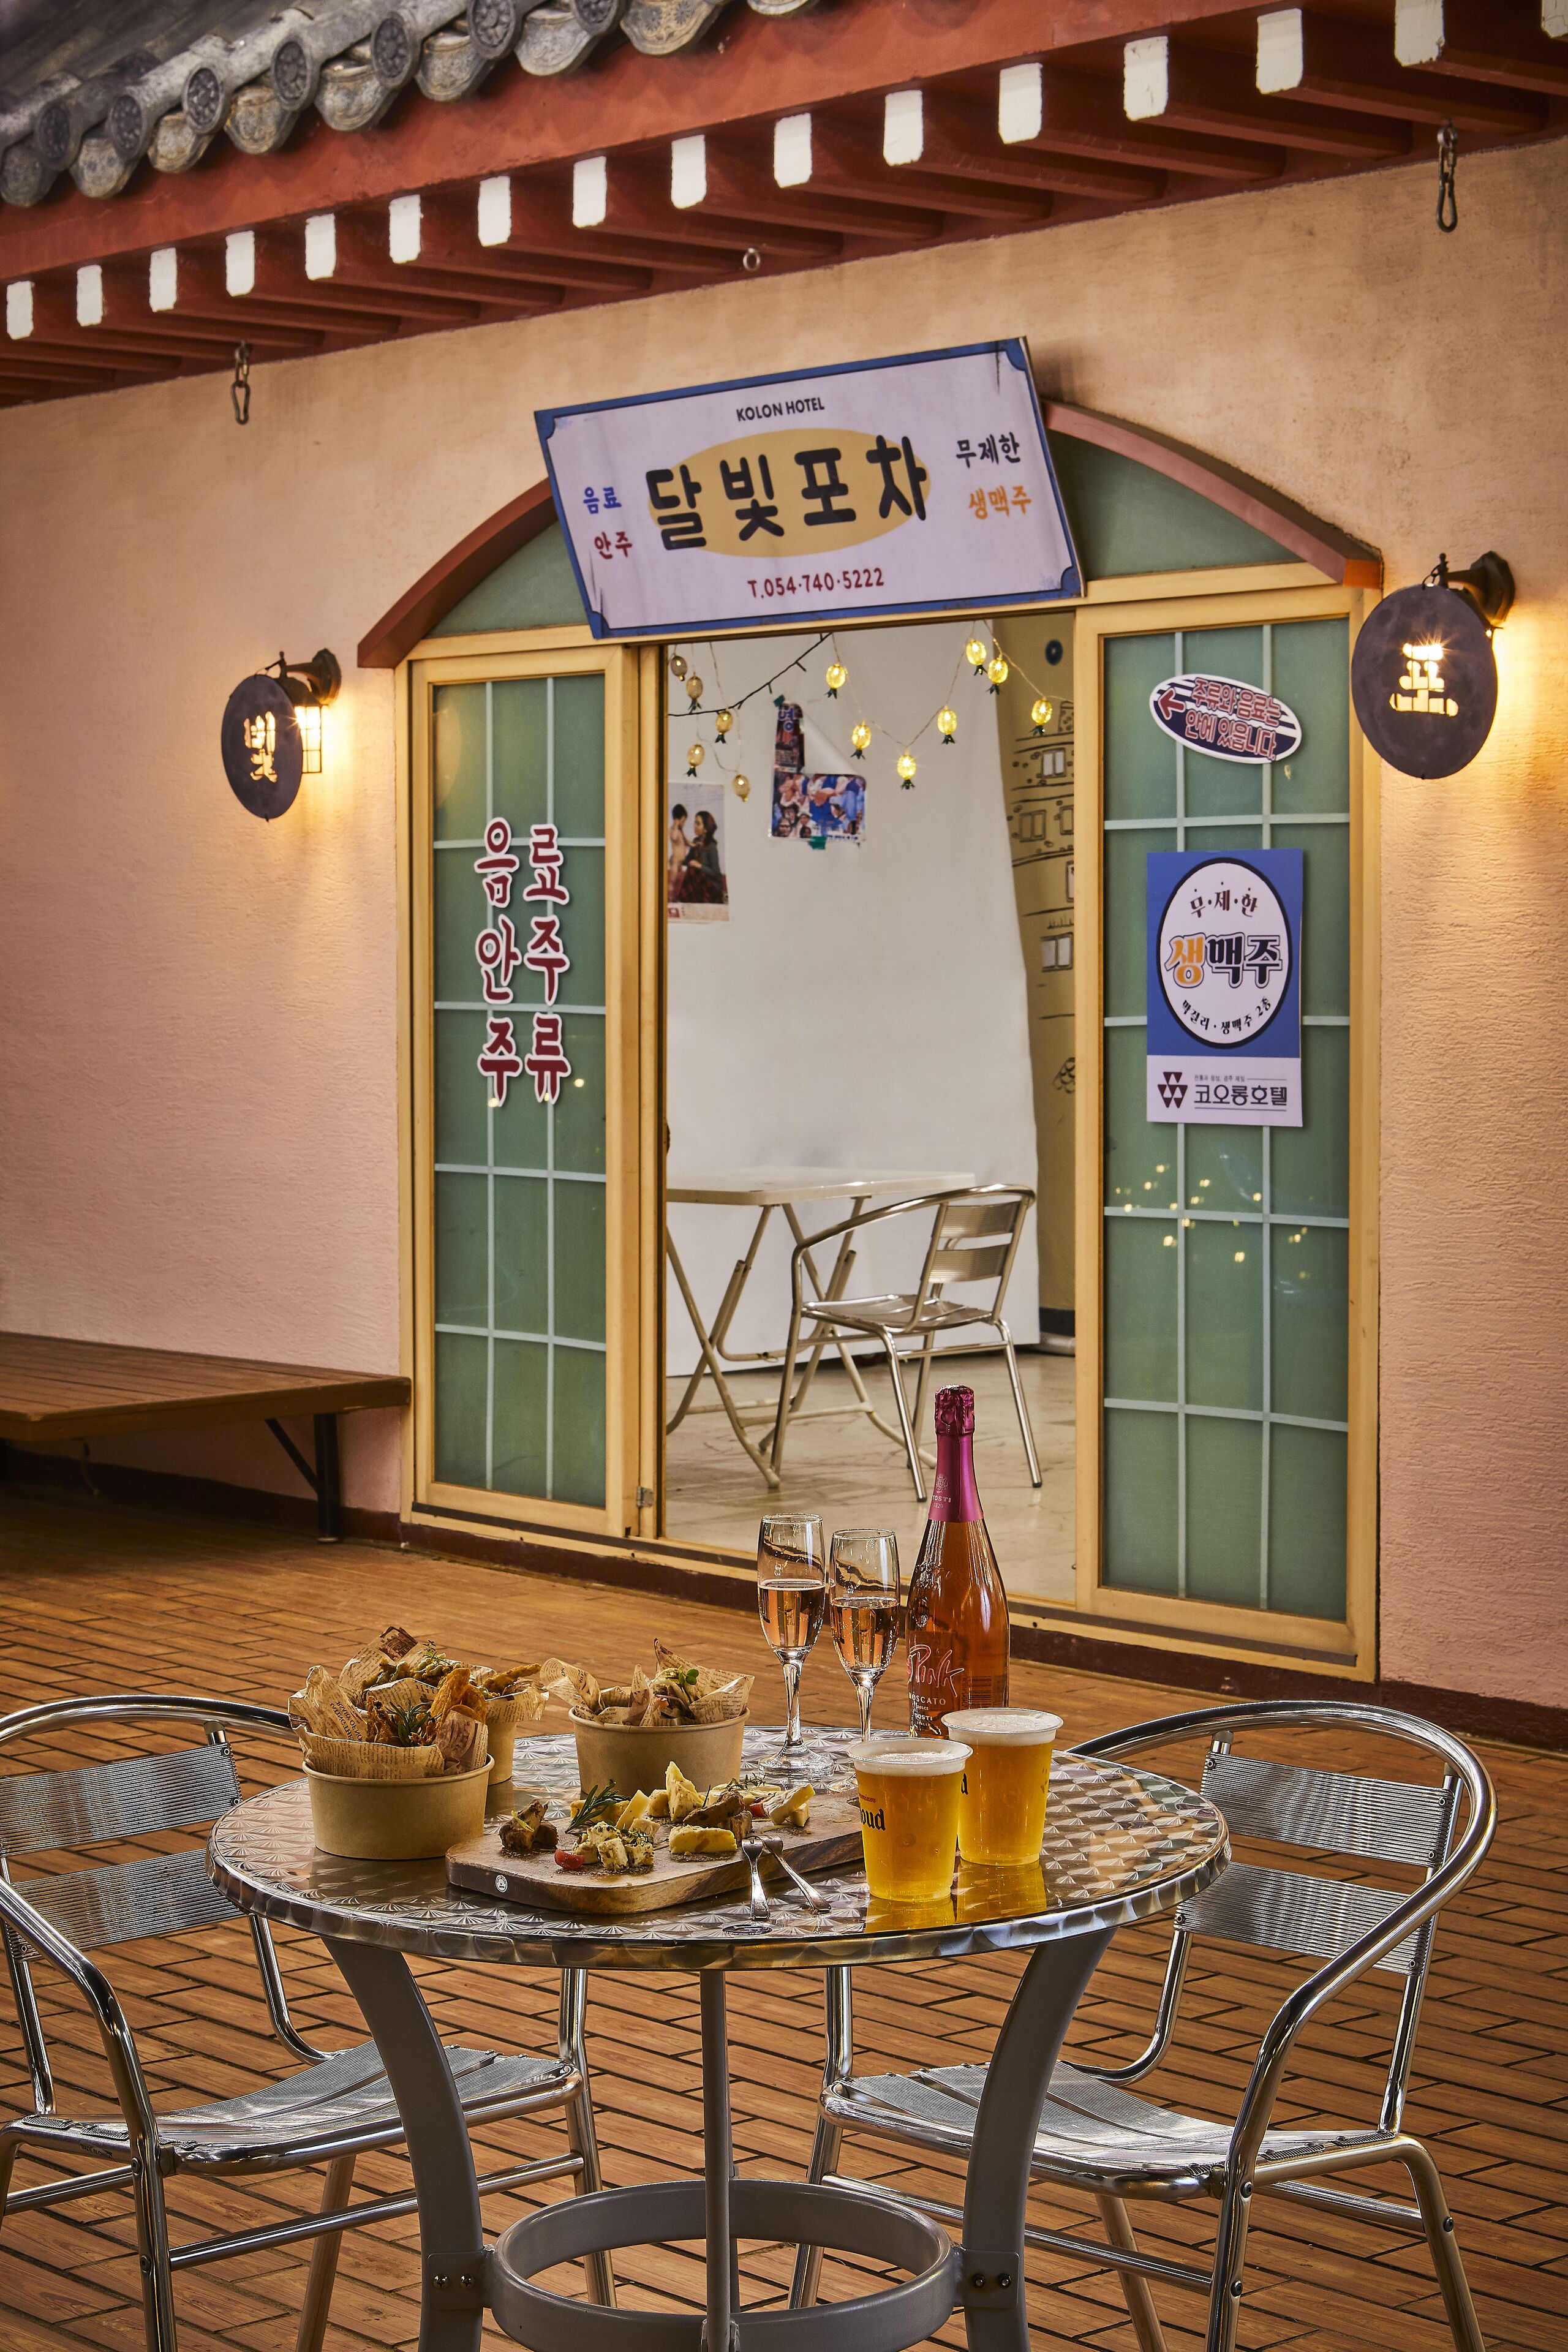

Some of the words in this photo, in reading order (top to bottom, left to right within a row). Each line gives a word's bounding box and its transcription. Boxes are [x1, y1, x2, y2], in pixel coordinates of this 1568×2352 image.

[736, 402, 783, 422] KOLON
[785, 397, 825, 415] HOTEL
[956, 431, 1021, 469] 무제한
[583, 486, 622, 514] 음료
[645, 434, 927, 551] 달빛포차
[968, 485, 1033, 520] 생맥주
[594, 530, 633, 560] 안주
[1191, 677, 1237, 715] 주류와
[1236, 689, 1281, 727] 음료는
[1185, 709, 1217, 743] 안에
[473, 816, 570, 908] 음료
[474, 914, 570, 1006] 안주
[1164, 932, 1283, 989] 생맥주
[1182, 1000, 1210, 1031] 막걸리
[1220, 1012, 1253, 1035] 생맥주
[1256, 996, 1272, 1017] 2종
[477, 1012, 571, 1107] 주류
[1194, 1084, 1287, 1106] 코오롱호텔
[932, 1494, 951, 1503] TOSTI
[908, 1692, 946, 1705] MOSCATO
[914, 1713, 933, 1721] TOSTI
[860, 1807, 886, 1831] oud
